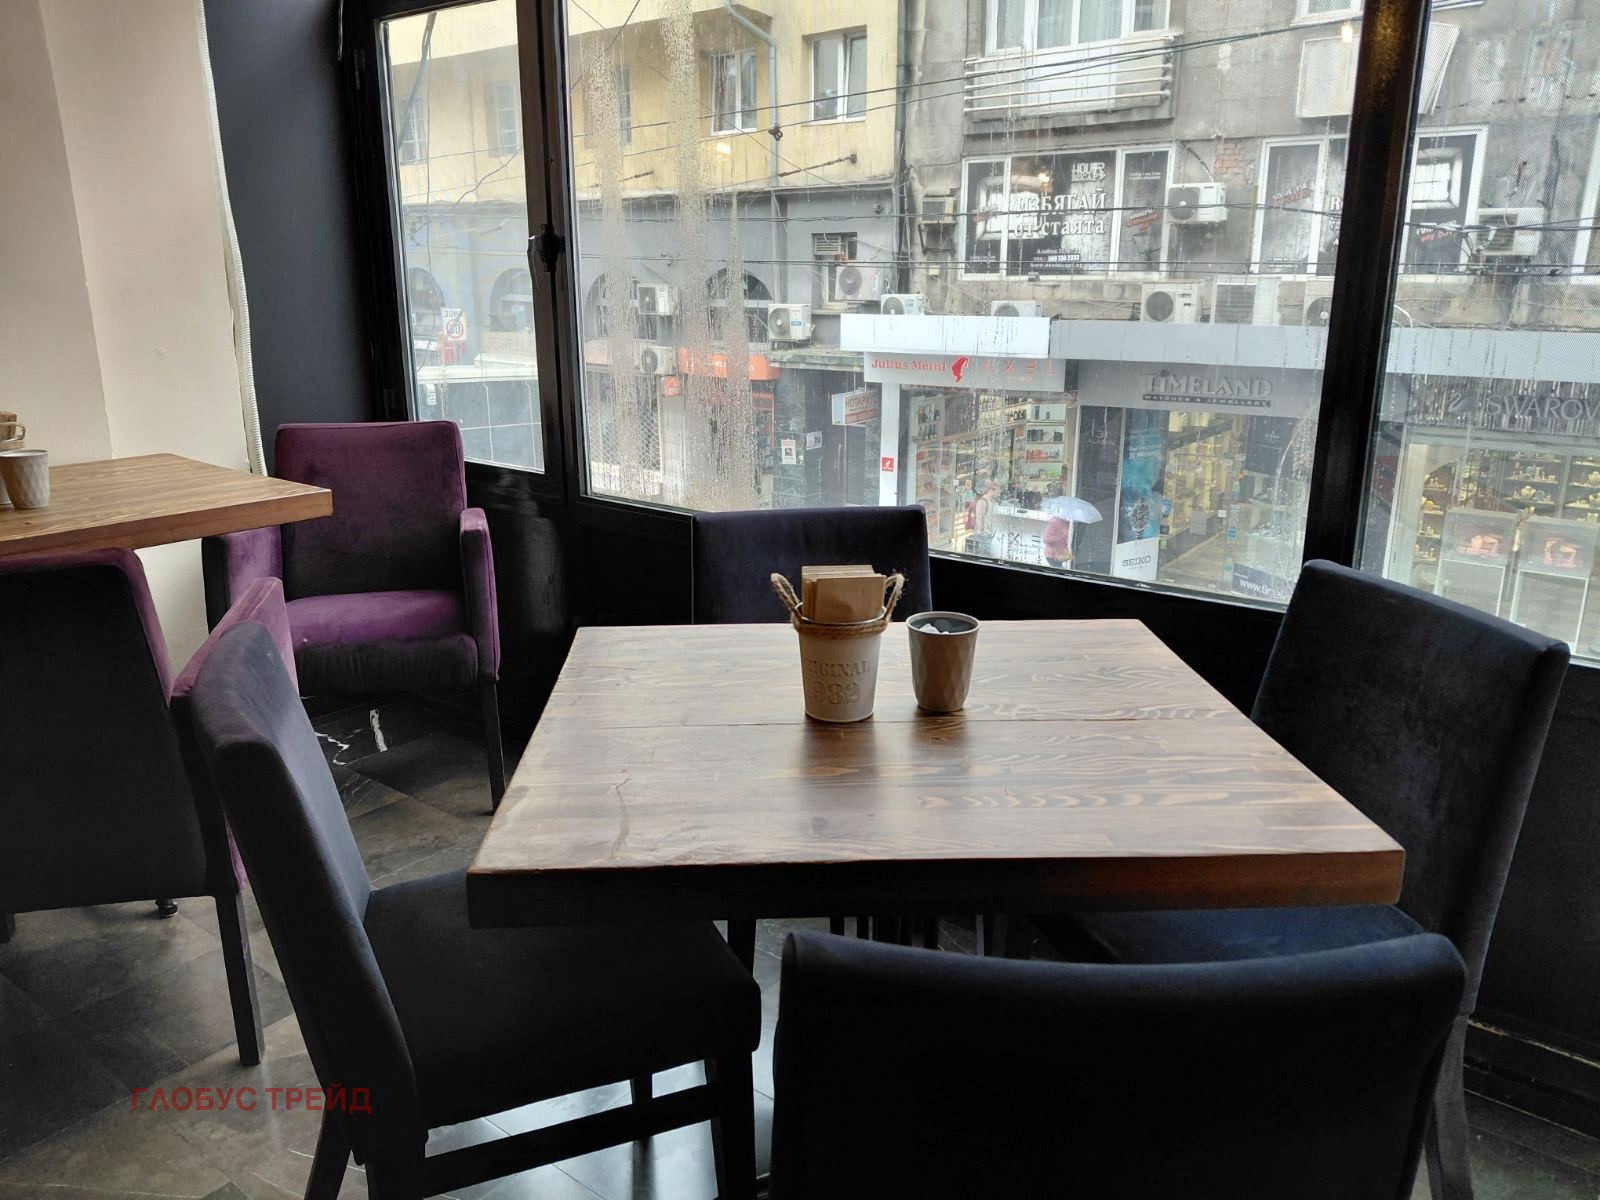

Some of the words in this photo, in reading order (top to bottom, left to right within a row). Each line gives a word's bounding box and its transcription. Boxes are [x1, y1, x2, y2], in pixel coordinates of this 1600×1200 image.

[1015, 187, 1107, 215] ИЗБЯГАЙ
[1041, 219, 1105, 236] стаята
[871, 358, 908, 369] Julius
[911, 359, 946, 371] Meinl
[1122, 555, 1152, 567] SEIKO
